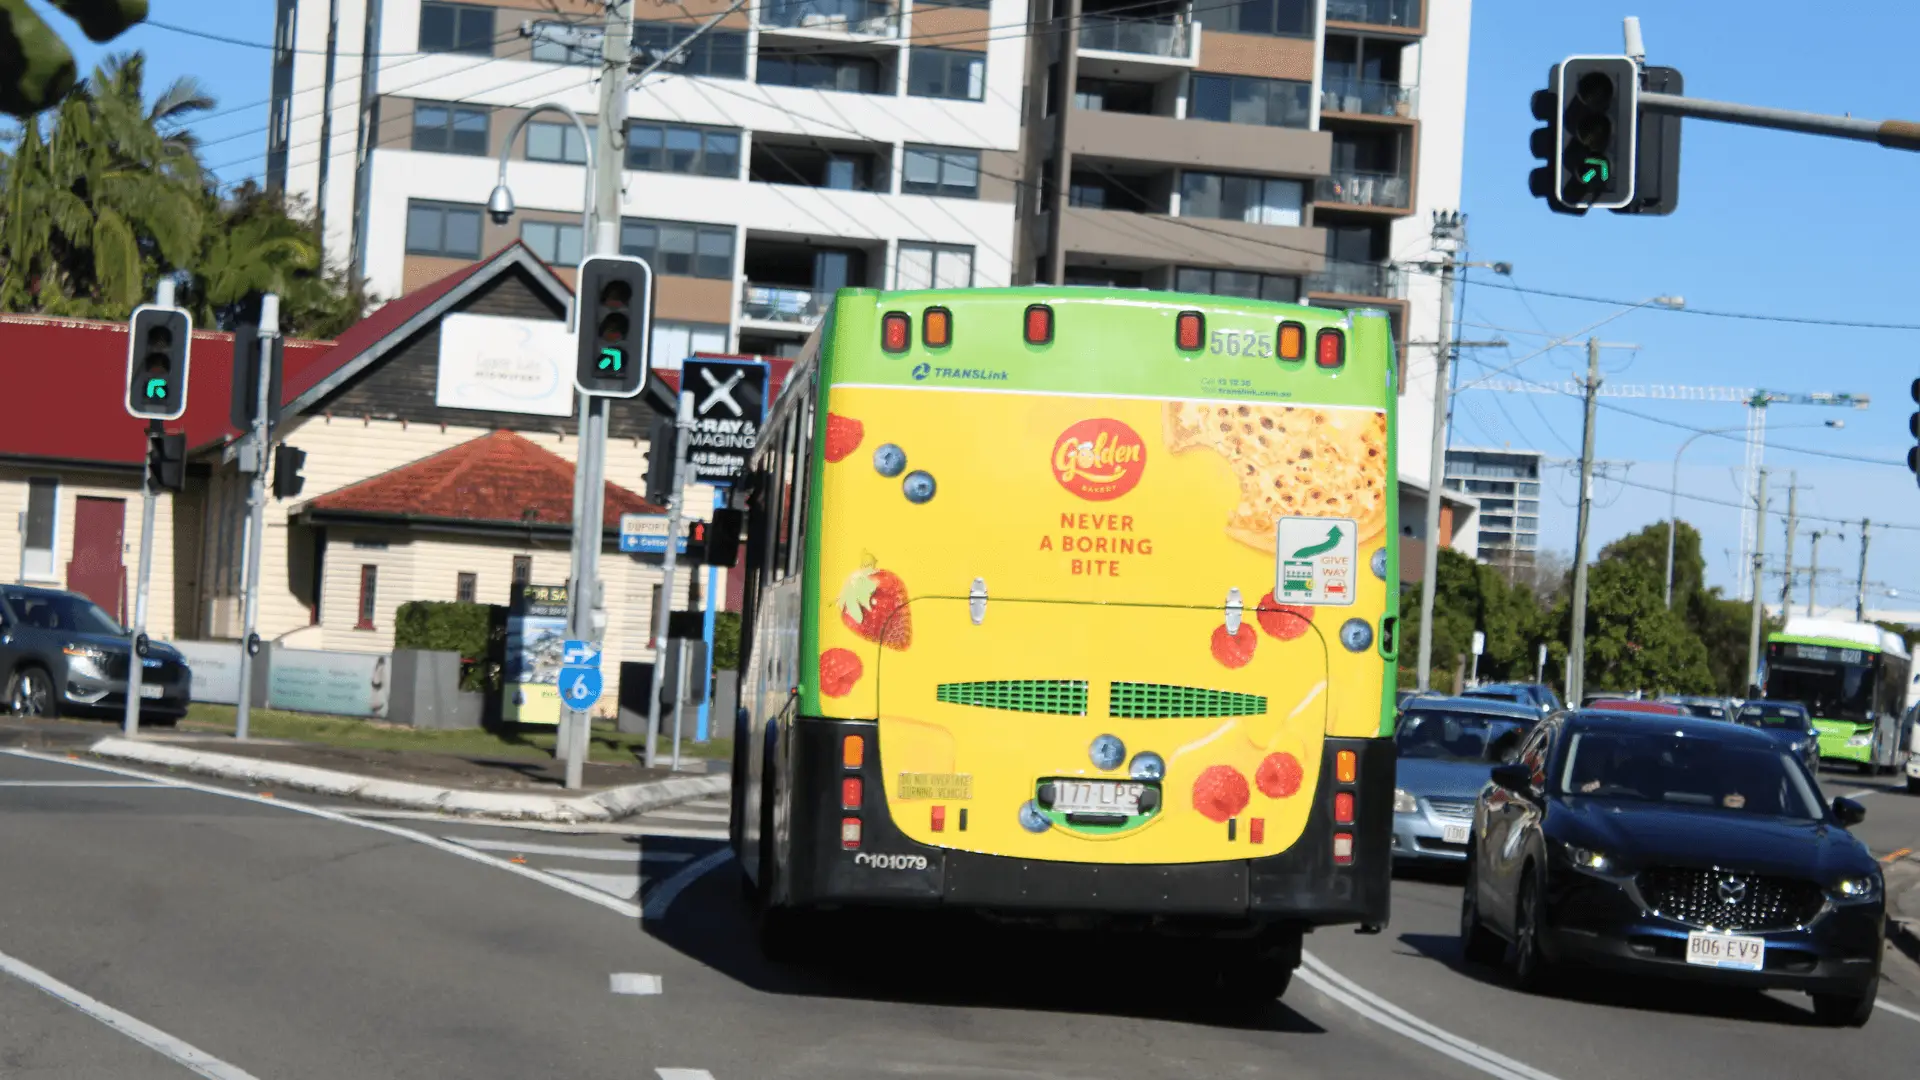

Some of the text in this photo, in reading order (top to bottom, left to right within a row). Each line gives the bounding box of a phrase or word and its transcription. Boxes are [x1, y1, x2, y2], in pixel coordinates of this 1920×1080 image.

[1210, 331, 1272, 358] 5625
[935, 367, 1009, 381] TRANSLink
[742, 421, 756, 436] &
[689, 432, 756, 449] MAGING
[1056, 431, 1141, 482] Golden
[1082, 485, 1117, 493] BAKERY
[626, 522, 667, 534] DUPORT
[1060, 512, 1134, 533] NEVER
[1039, 535, 1153, 555] A BORING
[1071, 559, 1120, 577] BITE
[1322, 556, 1349, 566] GIVE
[1322, 567, 1348, 577] WAY
[551, 589, 568, 602] SA
[572, 673, 588, 700] 6
